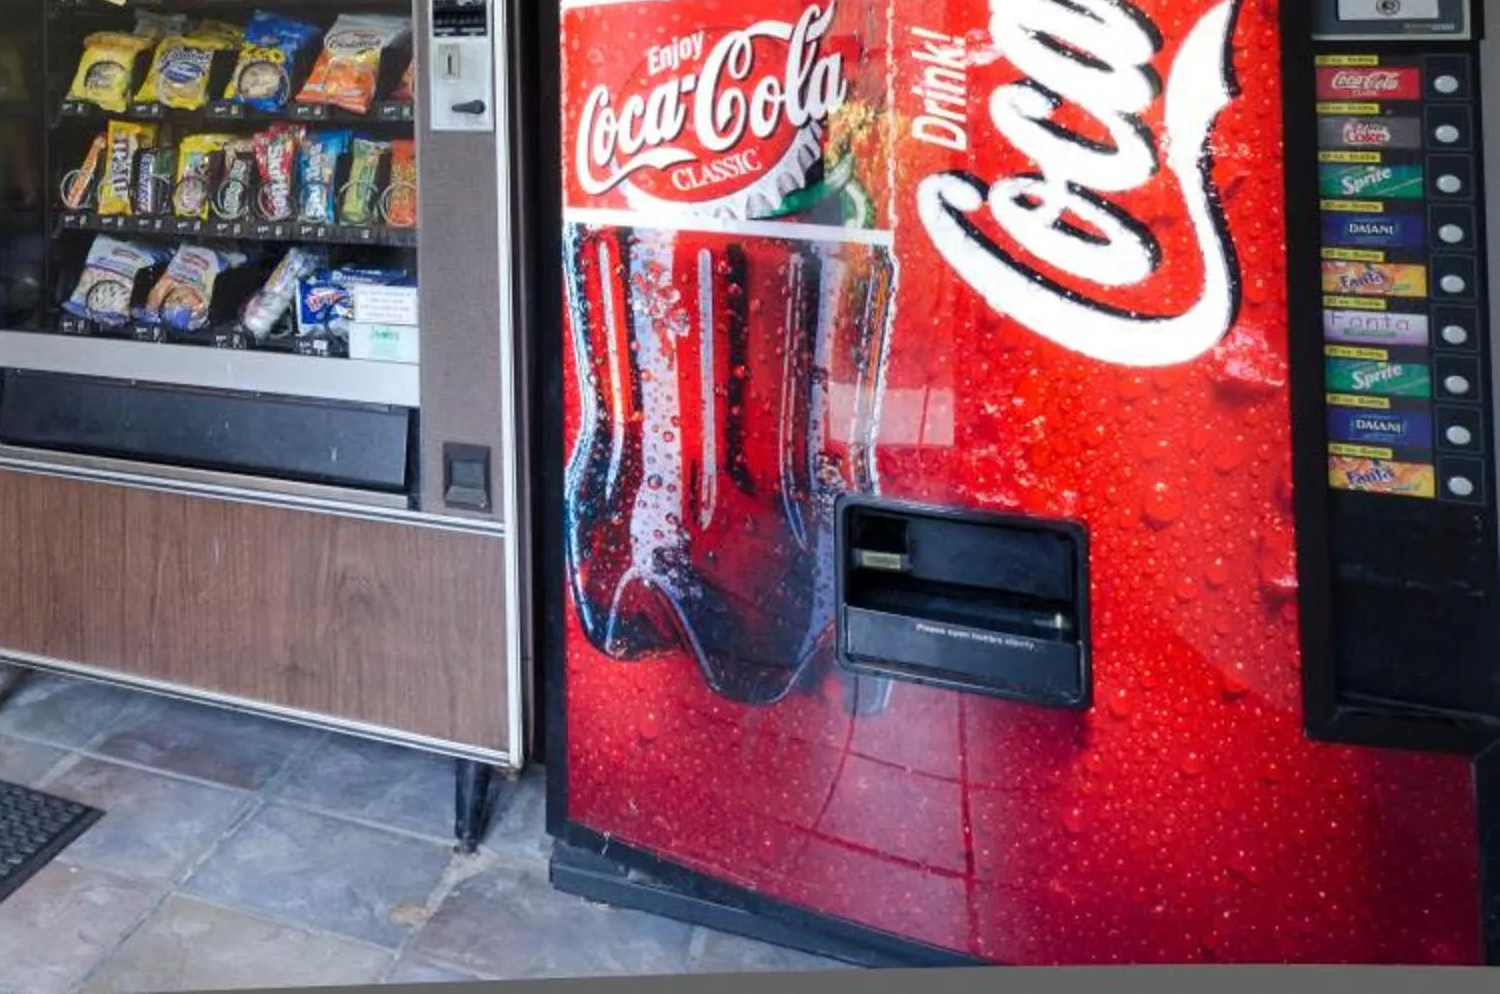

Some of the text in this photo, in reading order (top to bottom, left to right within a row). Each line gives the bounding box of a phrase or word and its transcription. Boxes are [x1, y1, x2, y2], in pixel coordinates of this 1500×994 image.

[646, 30, 705, 76] Enjoy
[911, 28, 969, 153] Drink!
[1331, 70, 1401, 91] Coca-Cola
[670, 148, 764, 192] CLASSIC
[1340, 166, 1393, 196] Sprite
[1348, 222, 1396, 236] DASANI
[1339, 269, 1386, 289] Fanta
[1330, 311, 1411, 332] Fanta
[1351, 363, 1404, 391] Sprite
[1355, 418, 1403, 434] DASANI
[1347, 465, 1397, 485] Fanta
